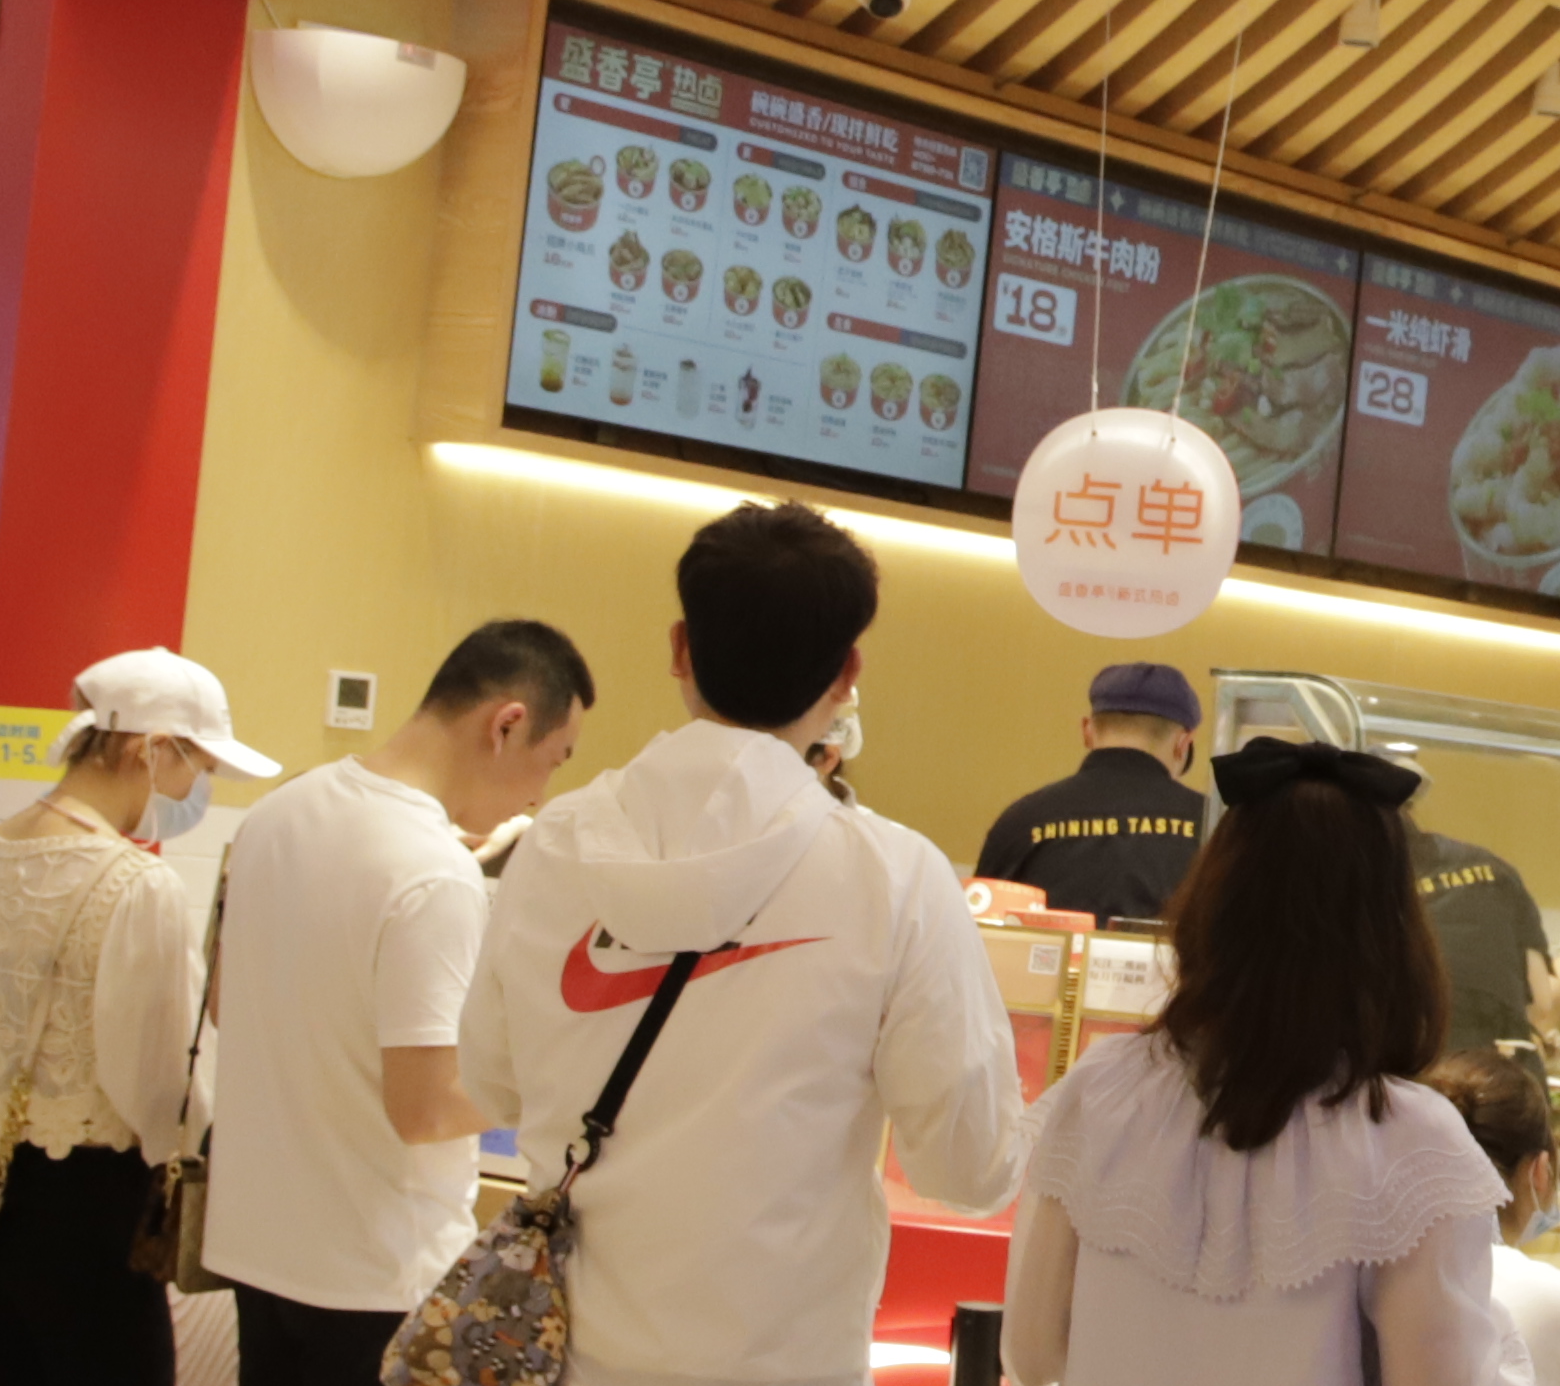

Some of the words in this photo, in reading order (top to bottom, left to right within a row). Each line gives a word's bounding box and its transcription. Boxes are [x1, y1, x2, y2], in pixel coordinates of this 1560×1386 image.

[1004, 210, 1161, 284] 安格斯牛肉粉
[1045, 473, 1203, 555] 点单
[1032, 817, 1120, 844] SHINING
[1128, 817, 1195, 839] TASTE
[1438, 863, 1496, 891] TASTE
